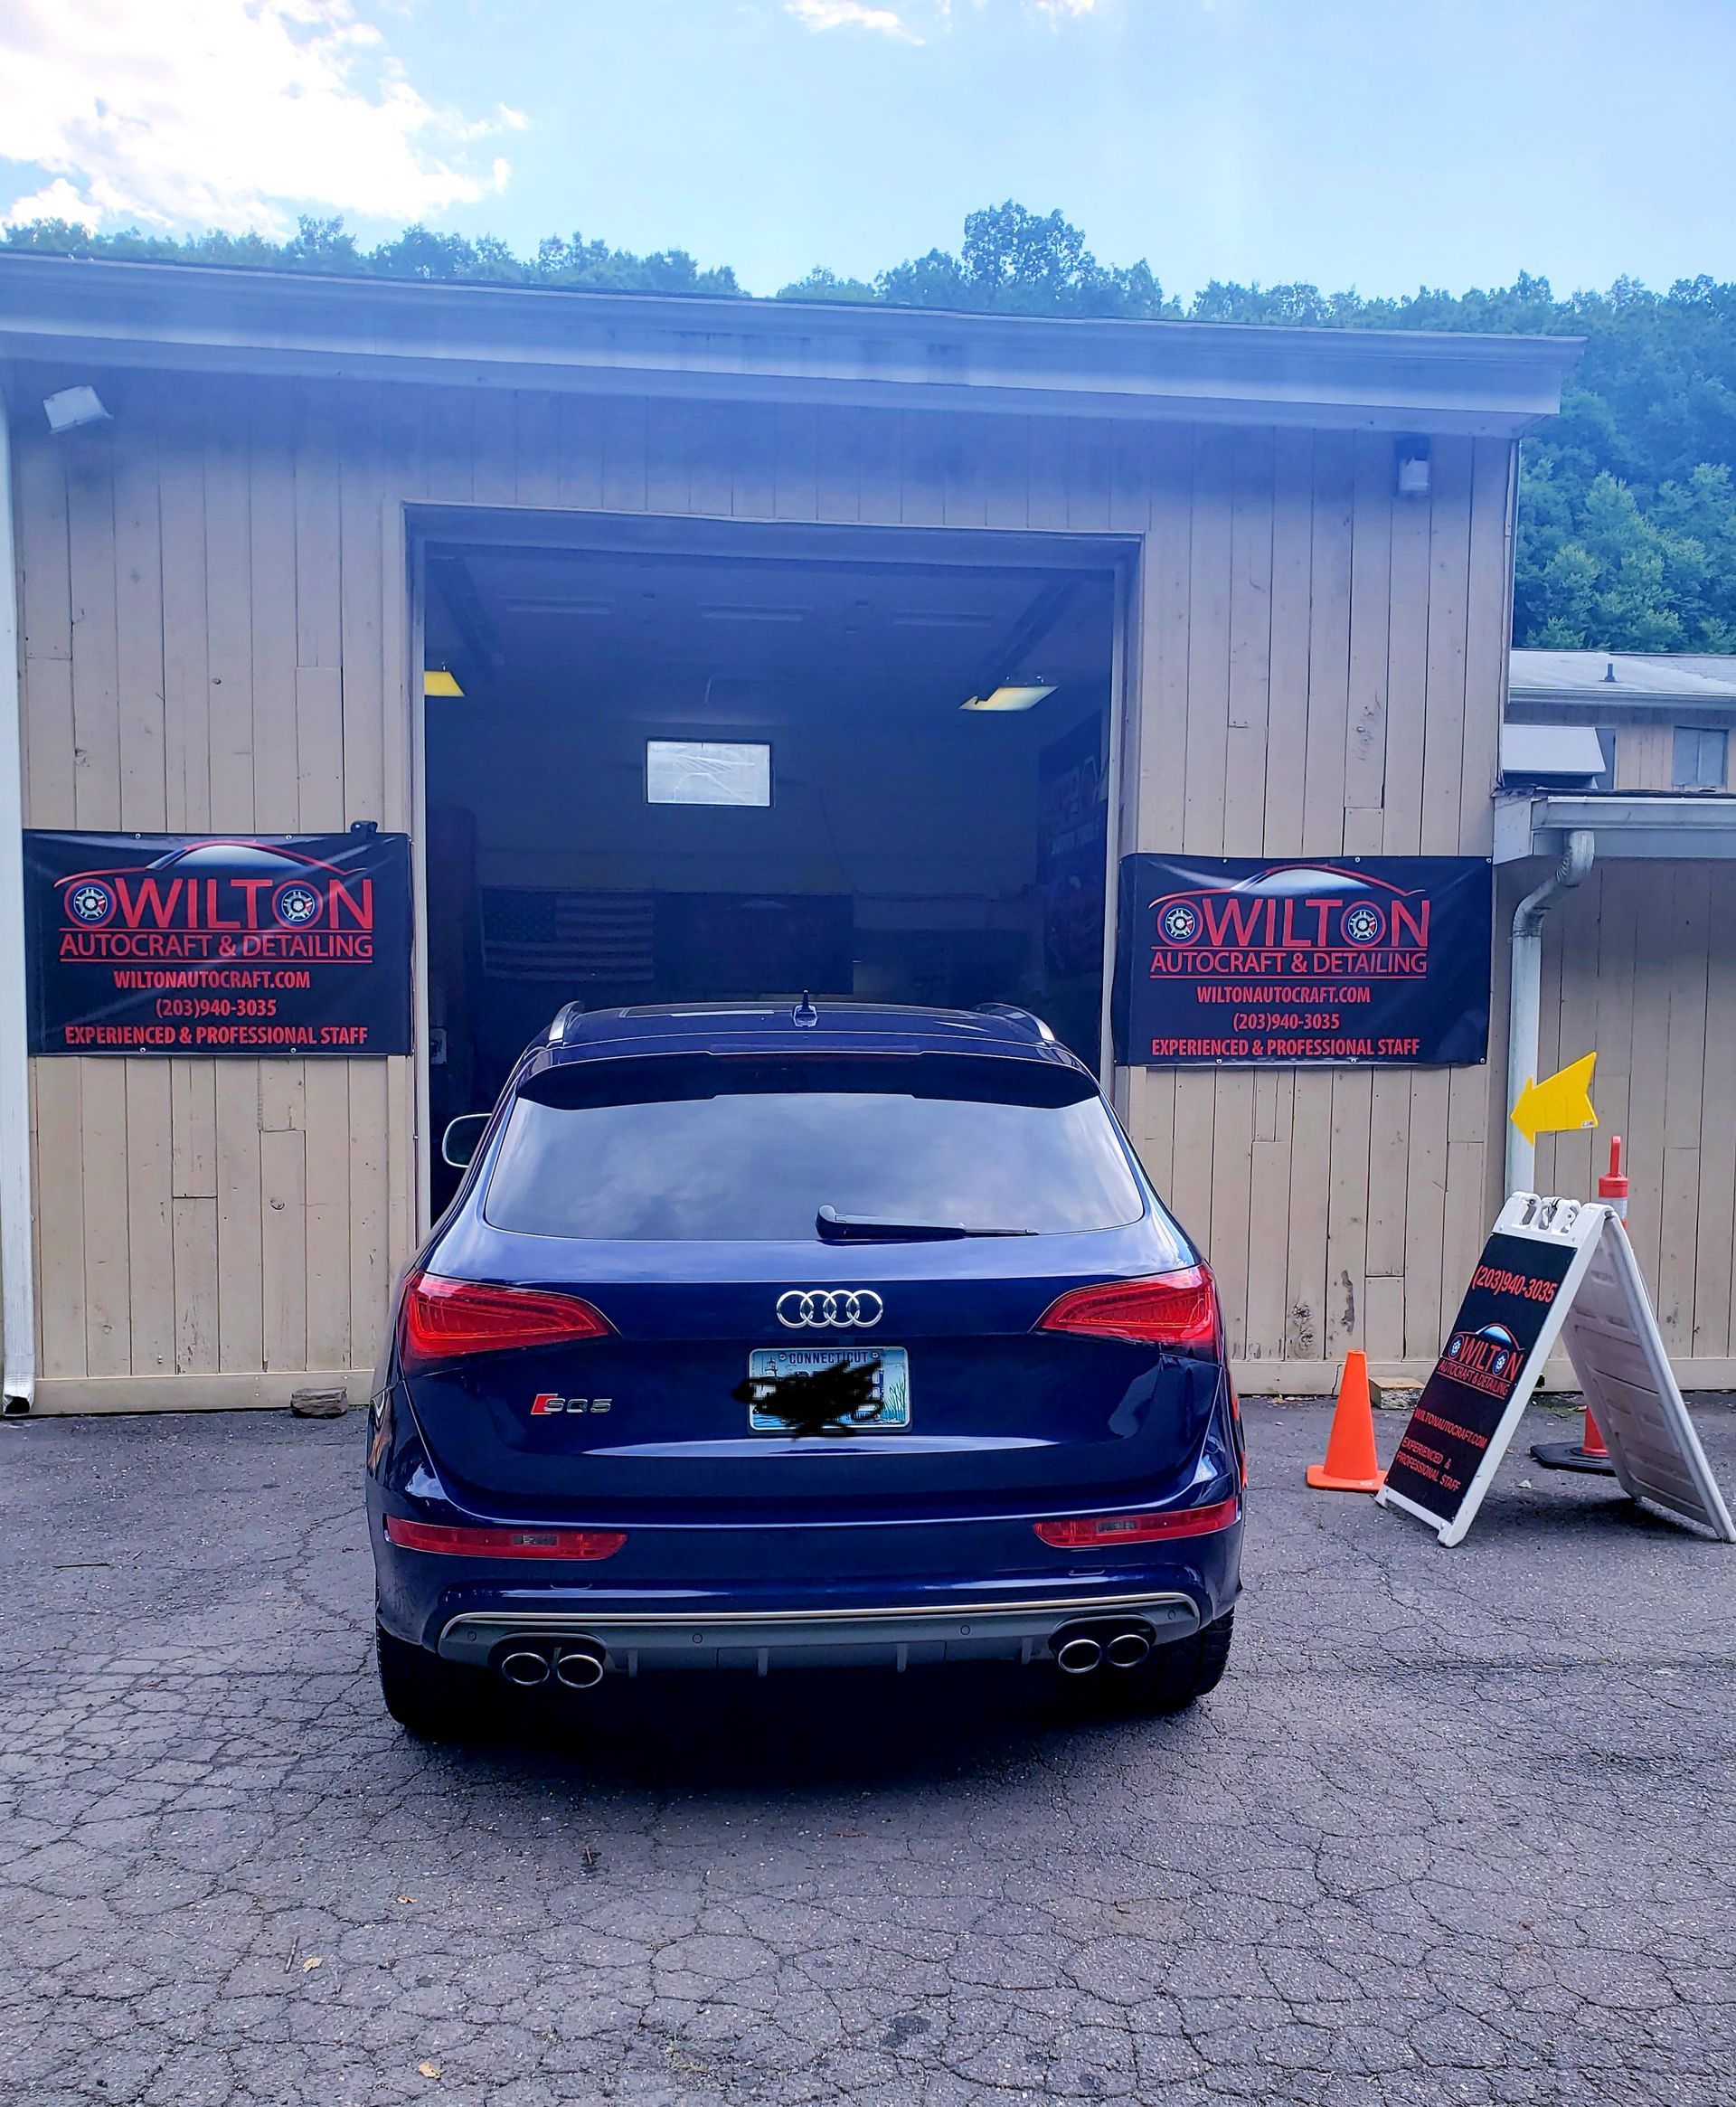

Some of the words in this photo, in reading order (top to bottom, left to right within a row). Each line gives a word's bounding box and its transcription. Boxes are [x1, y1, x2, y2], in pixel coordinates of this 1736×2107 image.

[60, 933, 212, 957] AUTOCRAFT
[219, 935, 237, 957] &
[242, 933, 373, 958] DETAILING
[1150, 951, 1287, 973] AUTOCRAFT
[1292, 952, 1307, 973] &
[1314, 951, 1428, 973] DETAILING
[114, 970, 310, 989] WILTONAUTOCRAFT.COM
[1196, 987, 1371, 1004] WILTONAUTOCRAFT.COM
[156, 998, 277, 1018] (203)940-3035
[1233, 1013, 1340, 1032] (203)940-3035
[65, 1026, 176, 1044] EXPERIENCED
[181, 1027, 192, 1044] &
[196, 1026, 316, 1044] PROFESSIONAL
[321, 1026, 368, 1044] STAFF
[1152, 1039, 1248, 1056] EXPERIENCED
[1251, 1039, 1263, 1055] &
[1267, 1038, 1374, 1056] PROFESSIONAL
[1378, 1038, 1420, 1055] STAFF
[1472, 1265, 1558, 1303] (203)940-3035
[789, 1351, 868, 1365] CONNECTICUT
[1438, 1360, 1474, 1381] AUTOCRAFT
[1472, 1373, 1480, 1384] &
[1477, 1374, 1510, 1395] DETAILING
[542, 1398, 612, 1413] SQ5
[1414, 1407, 1487, 1449] WILTONAUTOCRAFT.COM
[1401, 1437, 1444, 1465] EXPERIENCED
[1444, 1458, 1452, 1469] &
[1396, 1450, 1439, 1482] PROFESSIONAL
[1439, 1474, 1460, 1492] STAFF
